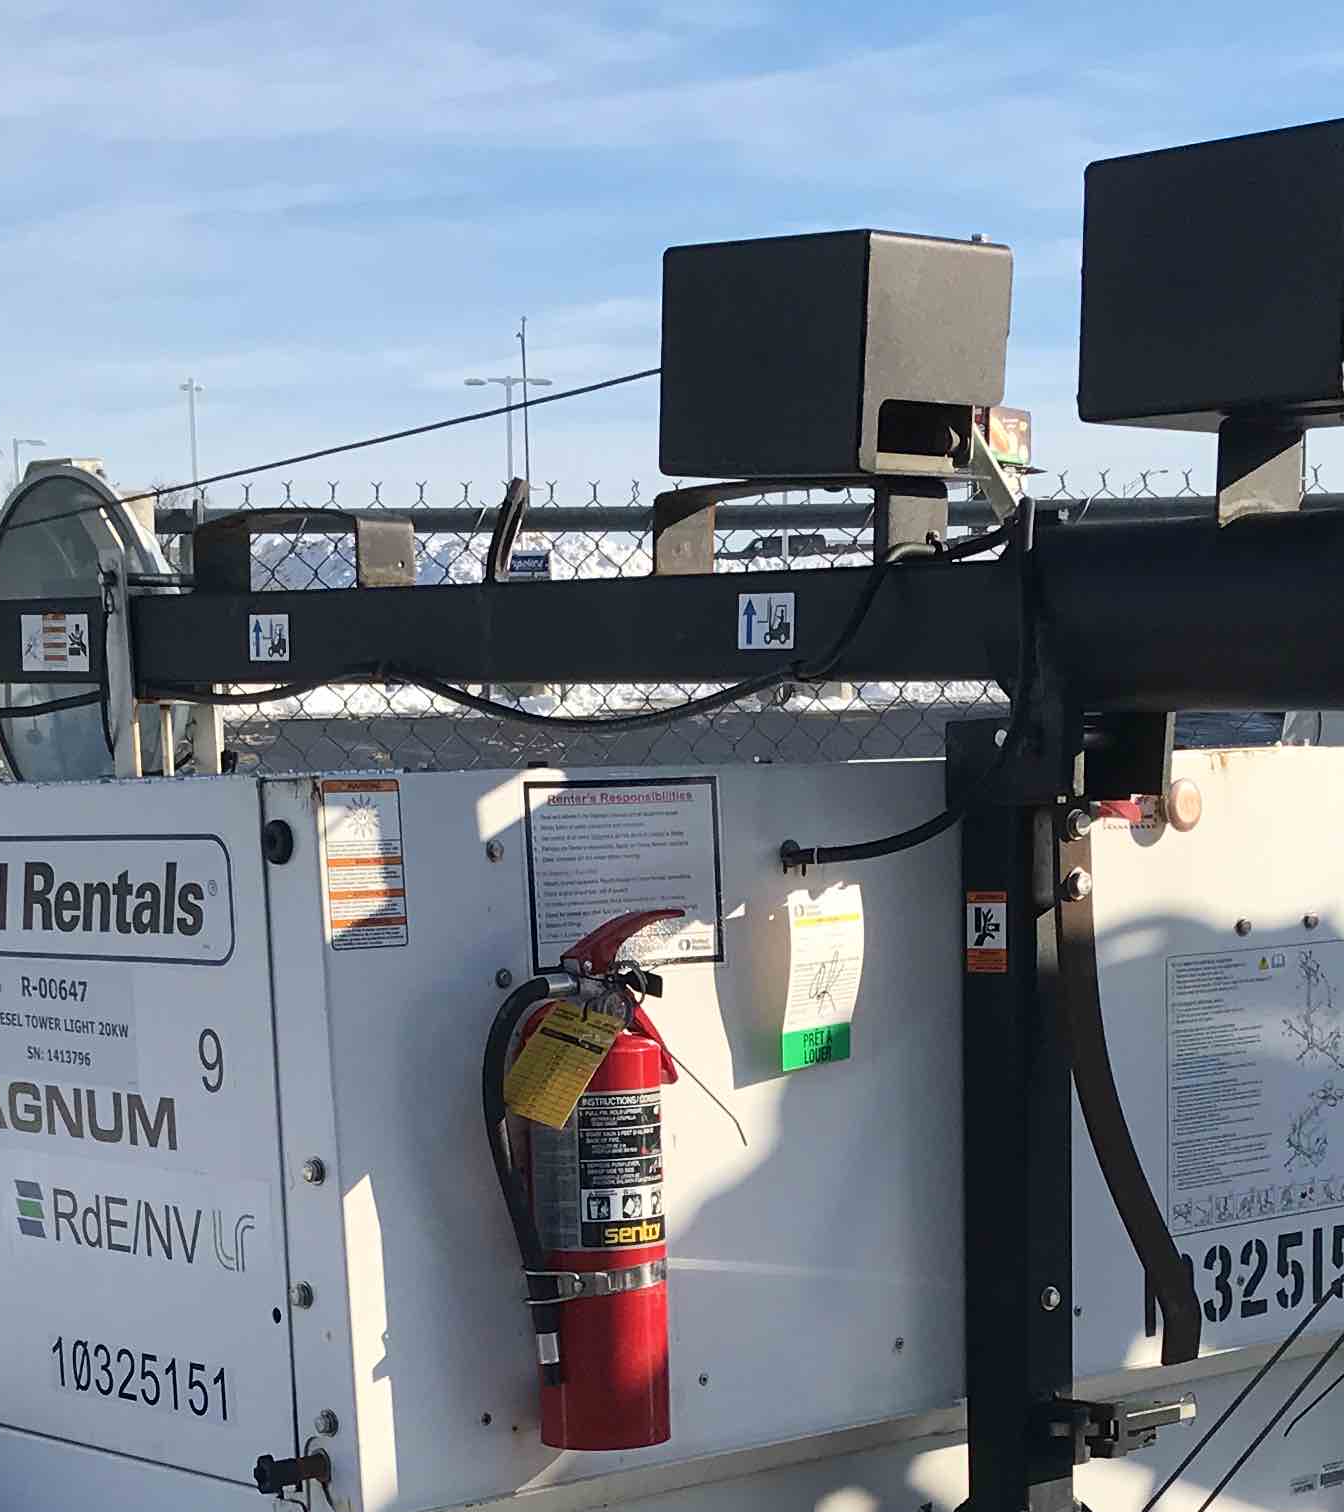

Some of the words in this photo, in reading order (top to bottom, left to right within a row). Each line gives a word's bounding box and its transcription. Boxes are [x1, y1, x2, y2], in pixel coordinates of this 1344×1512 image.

[600, 790, 693, 804] Responsibilities
[21, 976, 88, 1003] R-00647
[25, 1014, 61, 1031] TOWER
[64, 1018, 96, 1034] LIGHT
[98, 1022, 129, 1039] 20KW
[47, 1049, 91, 1067] 1413796
[198, 1028, 224, 1094] 9
[604, 1220, 661, 1244] sentry
[51, 1335, 229, 1422] 10325151
